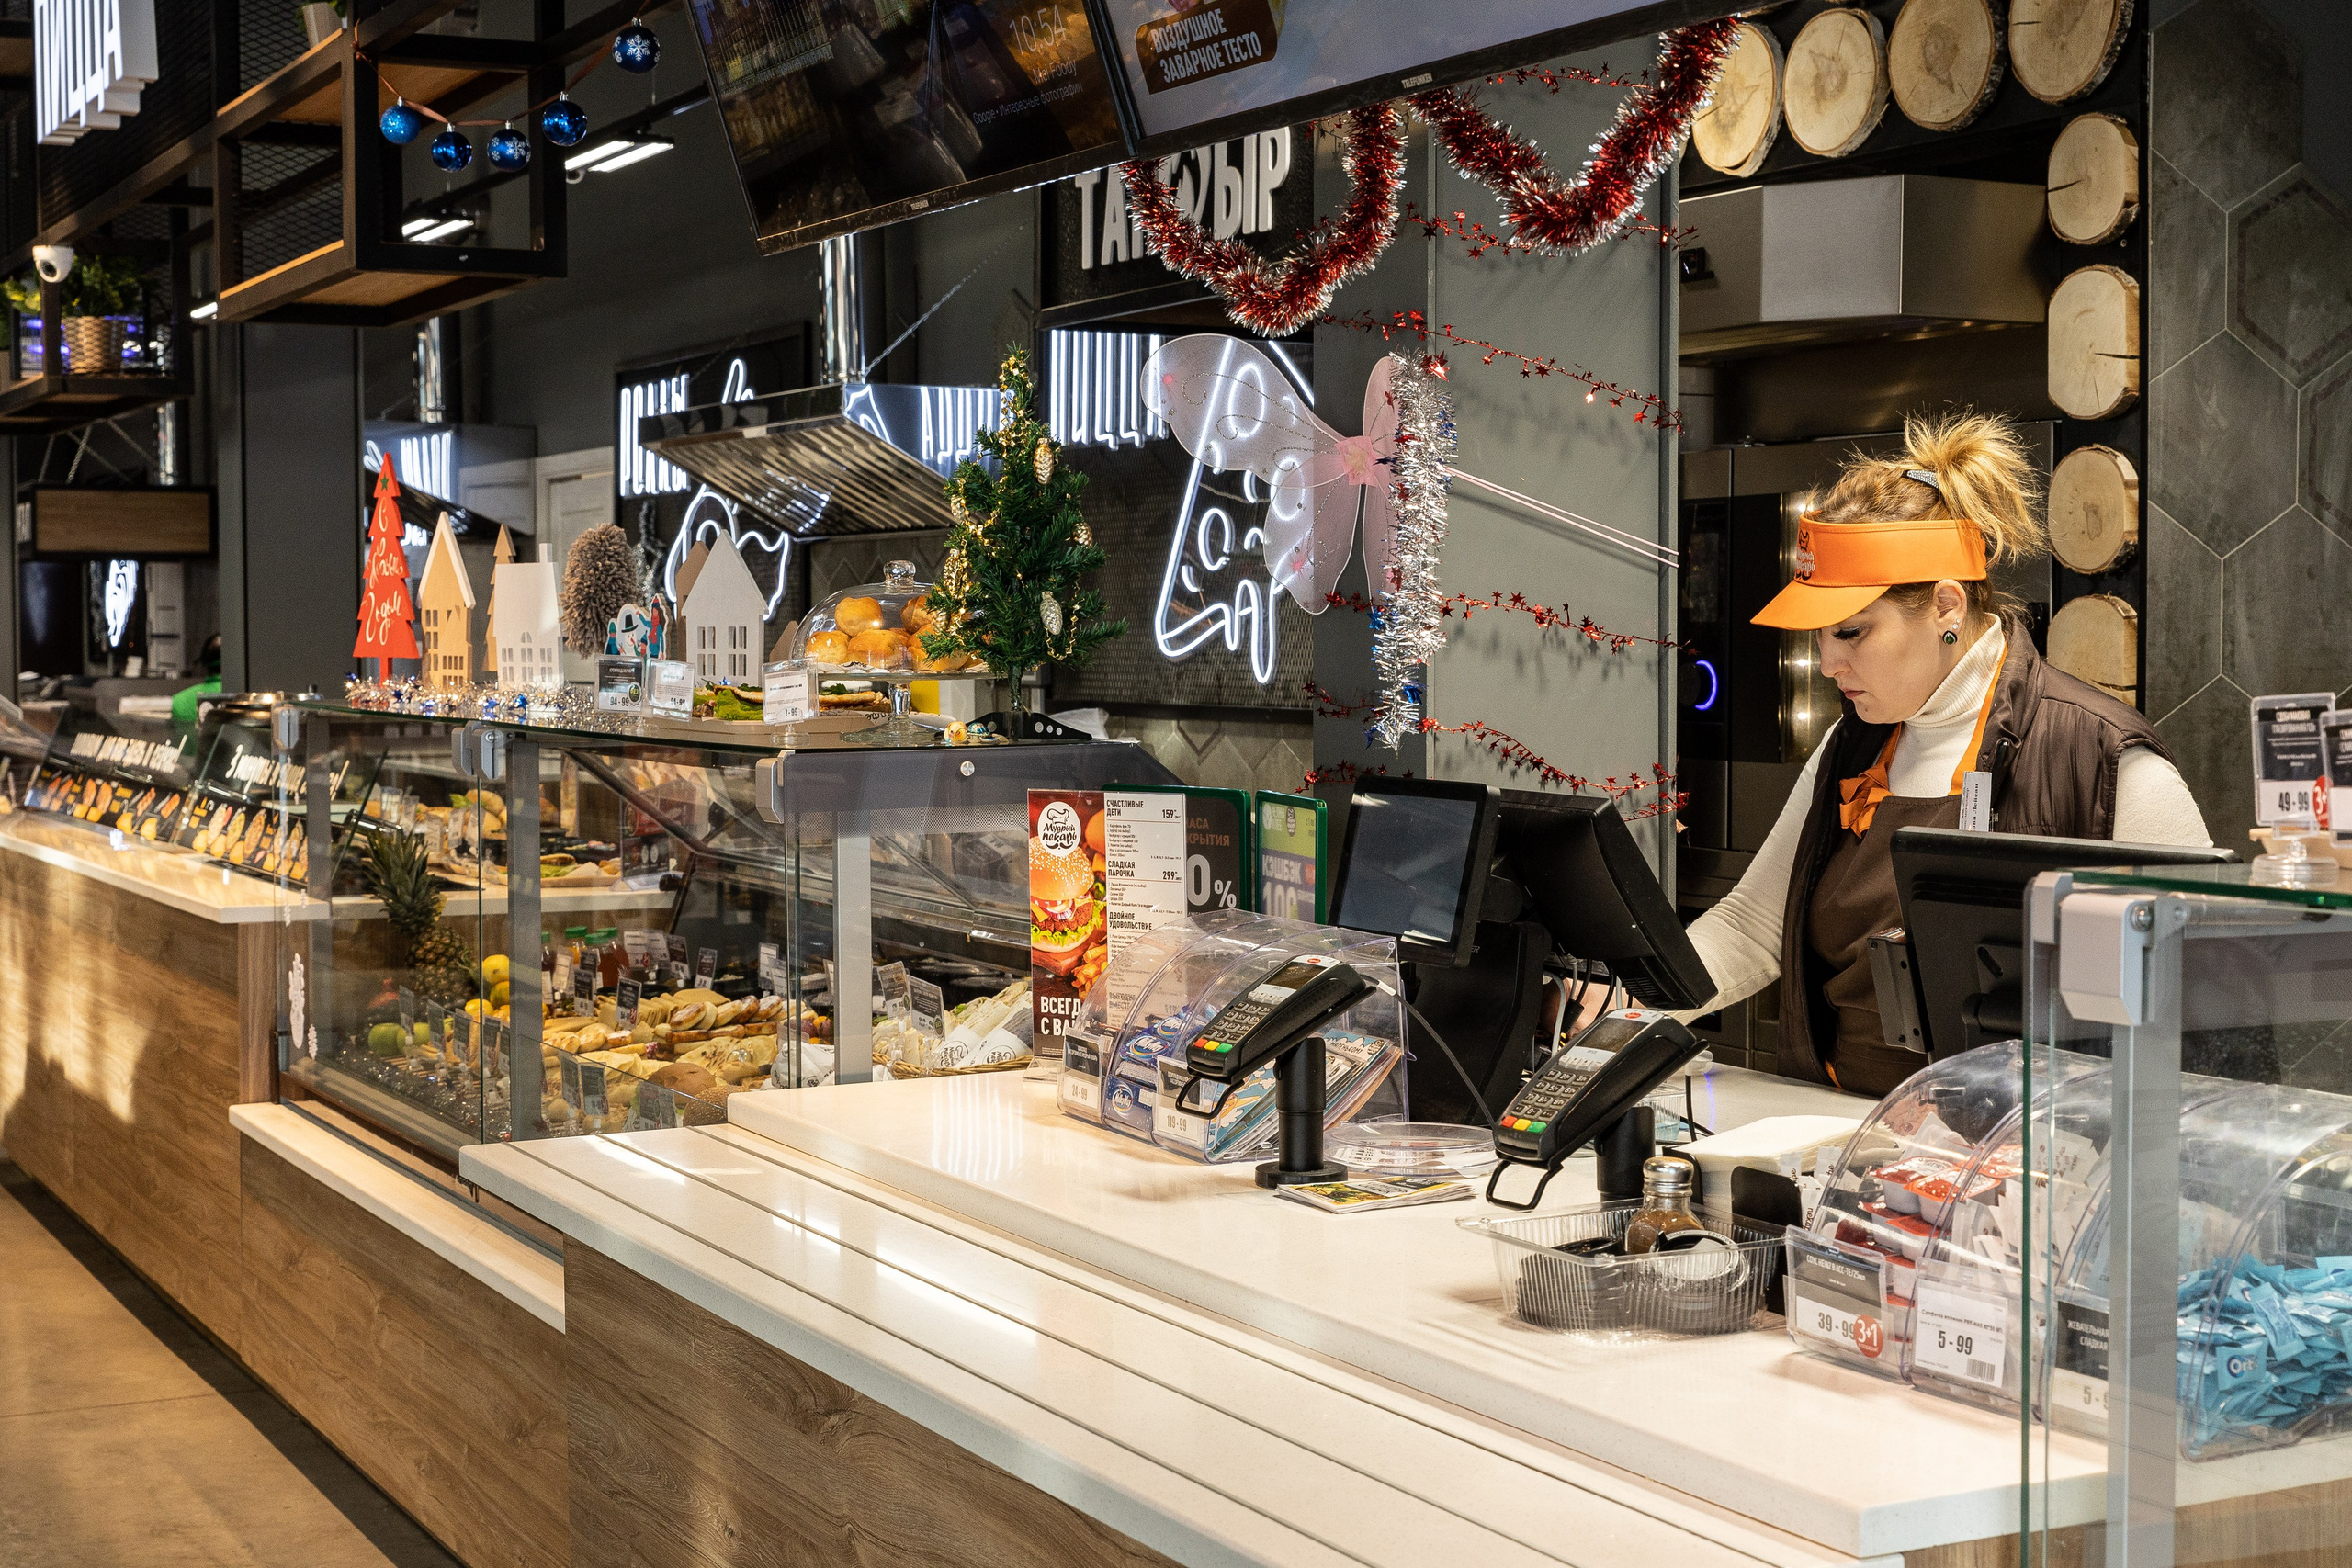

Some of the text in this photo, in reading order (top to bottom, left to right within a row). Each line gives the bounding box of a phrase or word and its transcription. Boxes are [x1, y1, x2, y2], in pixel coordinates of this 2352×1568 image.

[1009, 4, 1067, 56] 10:54
[1150, 8, 1227, 54] ВОЗДУШНОЕ
[1159, 31, 1262, 84] ЗАВАРНОЕ ТЕСТО
[973, 108, 998, 125] Google
[1106, 799, 1144, 808] СЧАСТЛИВЫЕ
[2278, 792, 2290, 811] 49
[2298, 791, 2309, 811] 99
[1106, 808, 1122, 817] ДЕТИ
[1043, 823, 1076, 833] Мудрый
[1042, 832, 1078, 845] пекарь
[1107, 860, 1136, 869] СЛАДКАЯ
[1262, 854, 1302, 885] КЭШБЭК
[1108, 869, 1175, 881] ПАРОЧКА 299
[1109, 911, 1136, 920] ДВОЙНОЕ
[1109, 920, 1153, 931] УДОВОЛЬСТВИЕ
[1040, 996, 1081, 1019] ВСЕГД
[1040, 1017, 1076, 1037] С ВА
[1818, 1258, 1832, 1269] HEINZ
[1818, 1312, 1833, 1332] 39
[1841, 1320, 1855, 1340] 99
[1857, 1318, 1878, 1348] 3+1
[1938, 1329, 1946, 1349] 5
[1956, 1335, 1973, 1356] 99
[2083, 1385, 2092, 1405] 5
